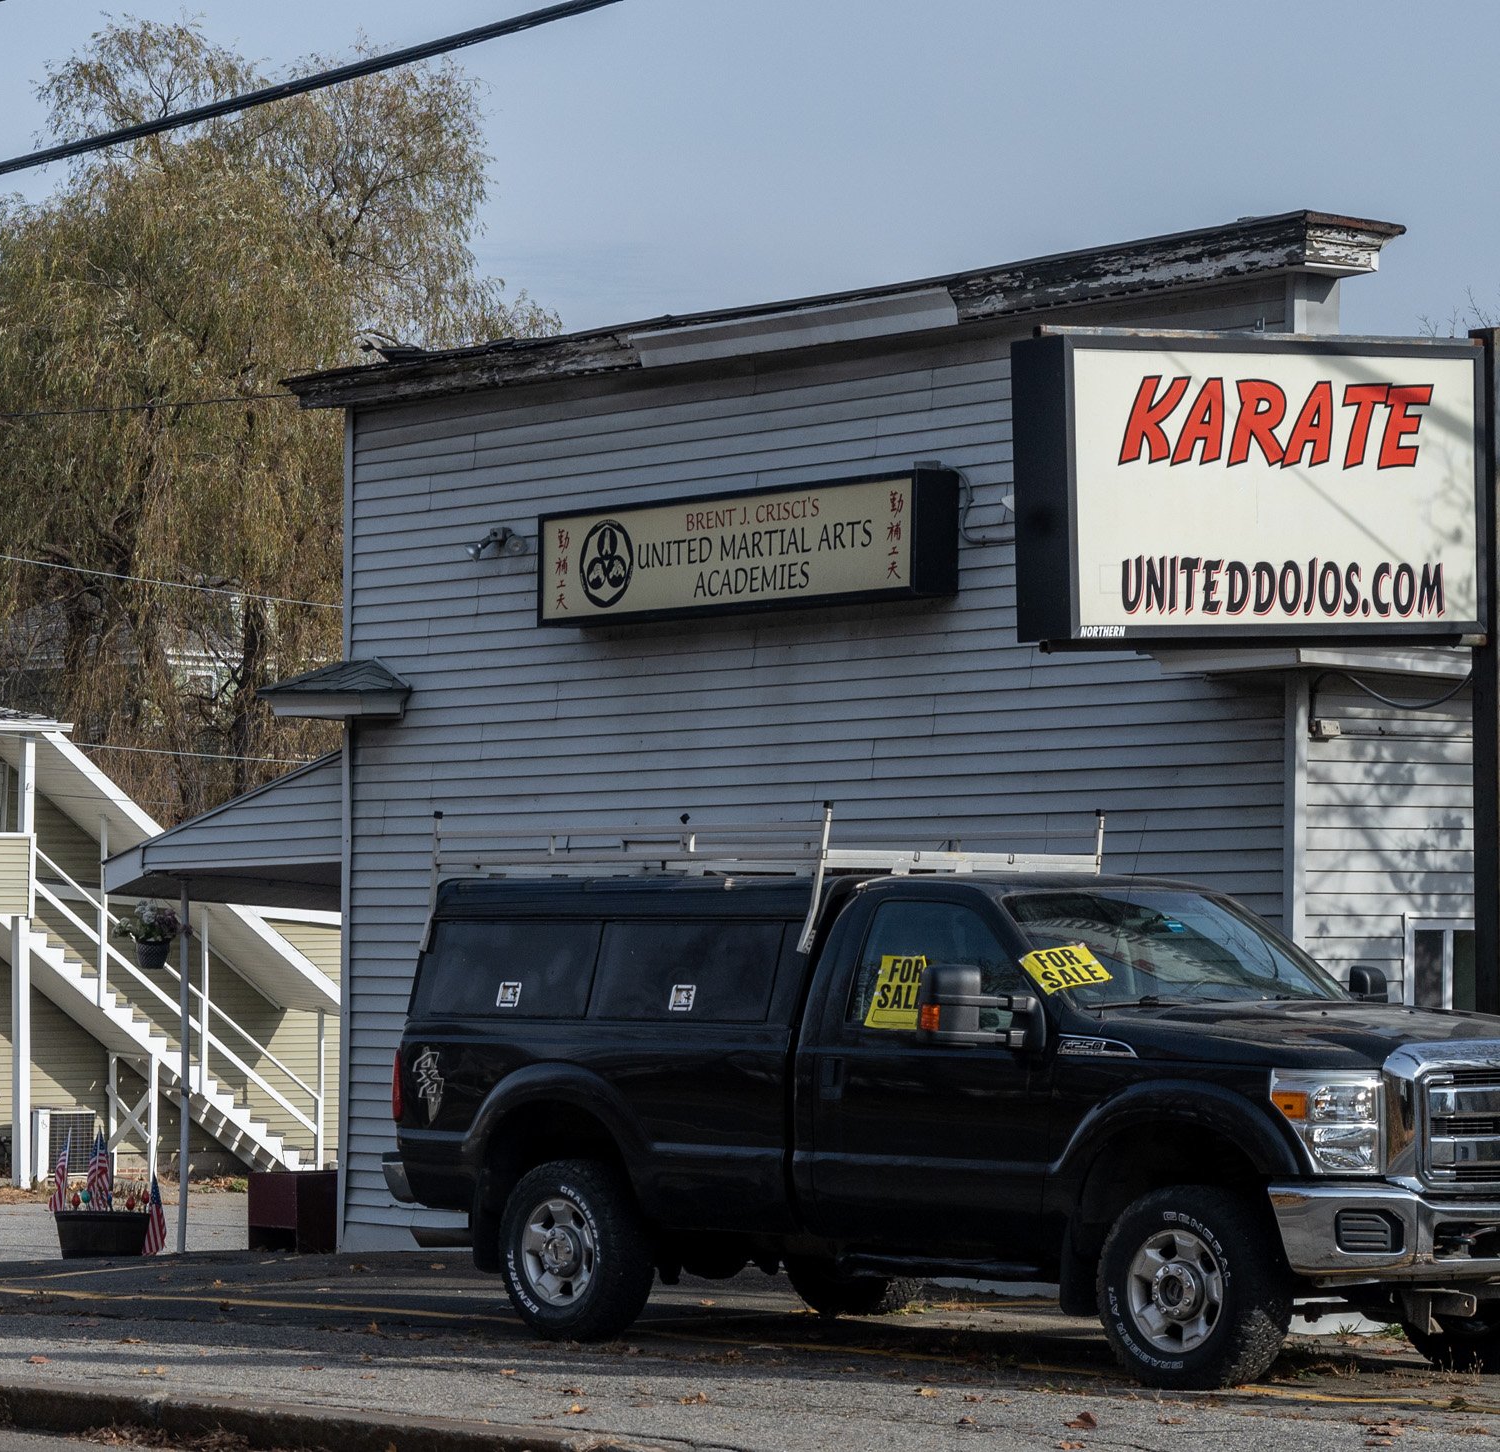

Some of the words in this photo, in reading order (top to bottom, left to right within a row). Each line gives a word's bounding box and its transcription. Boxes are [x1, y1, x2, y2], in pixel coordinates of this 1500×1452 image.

[1117, 373, 1435, 471] KARATE
[686, 507, 737, 532] BRENT
[739, 506, 750, 526] J.
[755, 496, 820, 523] CRISCI'S
[637, 535, 713, 569] UNITED
[720, 527, 812, 562] MARTIAL
[817, 519, 873, 552] ARTS
[693, 560, 810, 599] ACADEMIES
[1120, 554, 1446, 619] UNITEDDOJOS.COM
[1080, 624, 1126, 637] NORTHERN
[889, 958, 923, 983] FOR
[1033, 948, 1082, 970] FOR
[1042, 963, 1105, 989] SALE
[560, 1185, 598, 1239] GRABBER
[1163, 1211, 1232, 1287] GENERAL
[506, 1249, 540, 1314] GENERAL
[1116, 1321, 1184, 1369] GRABBER
